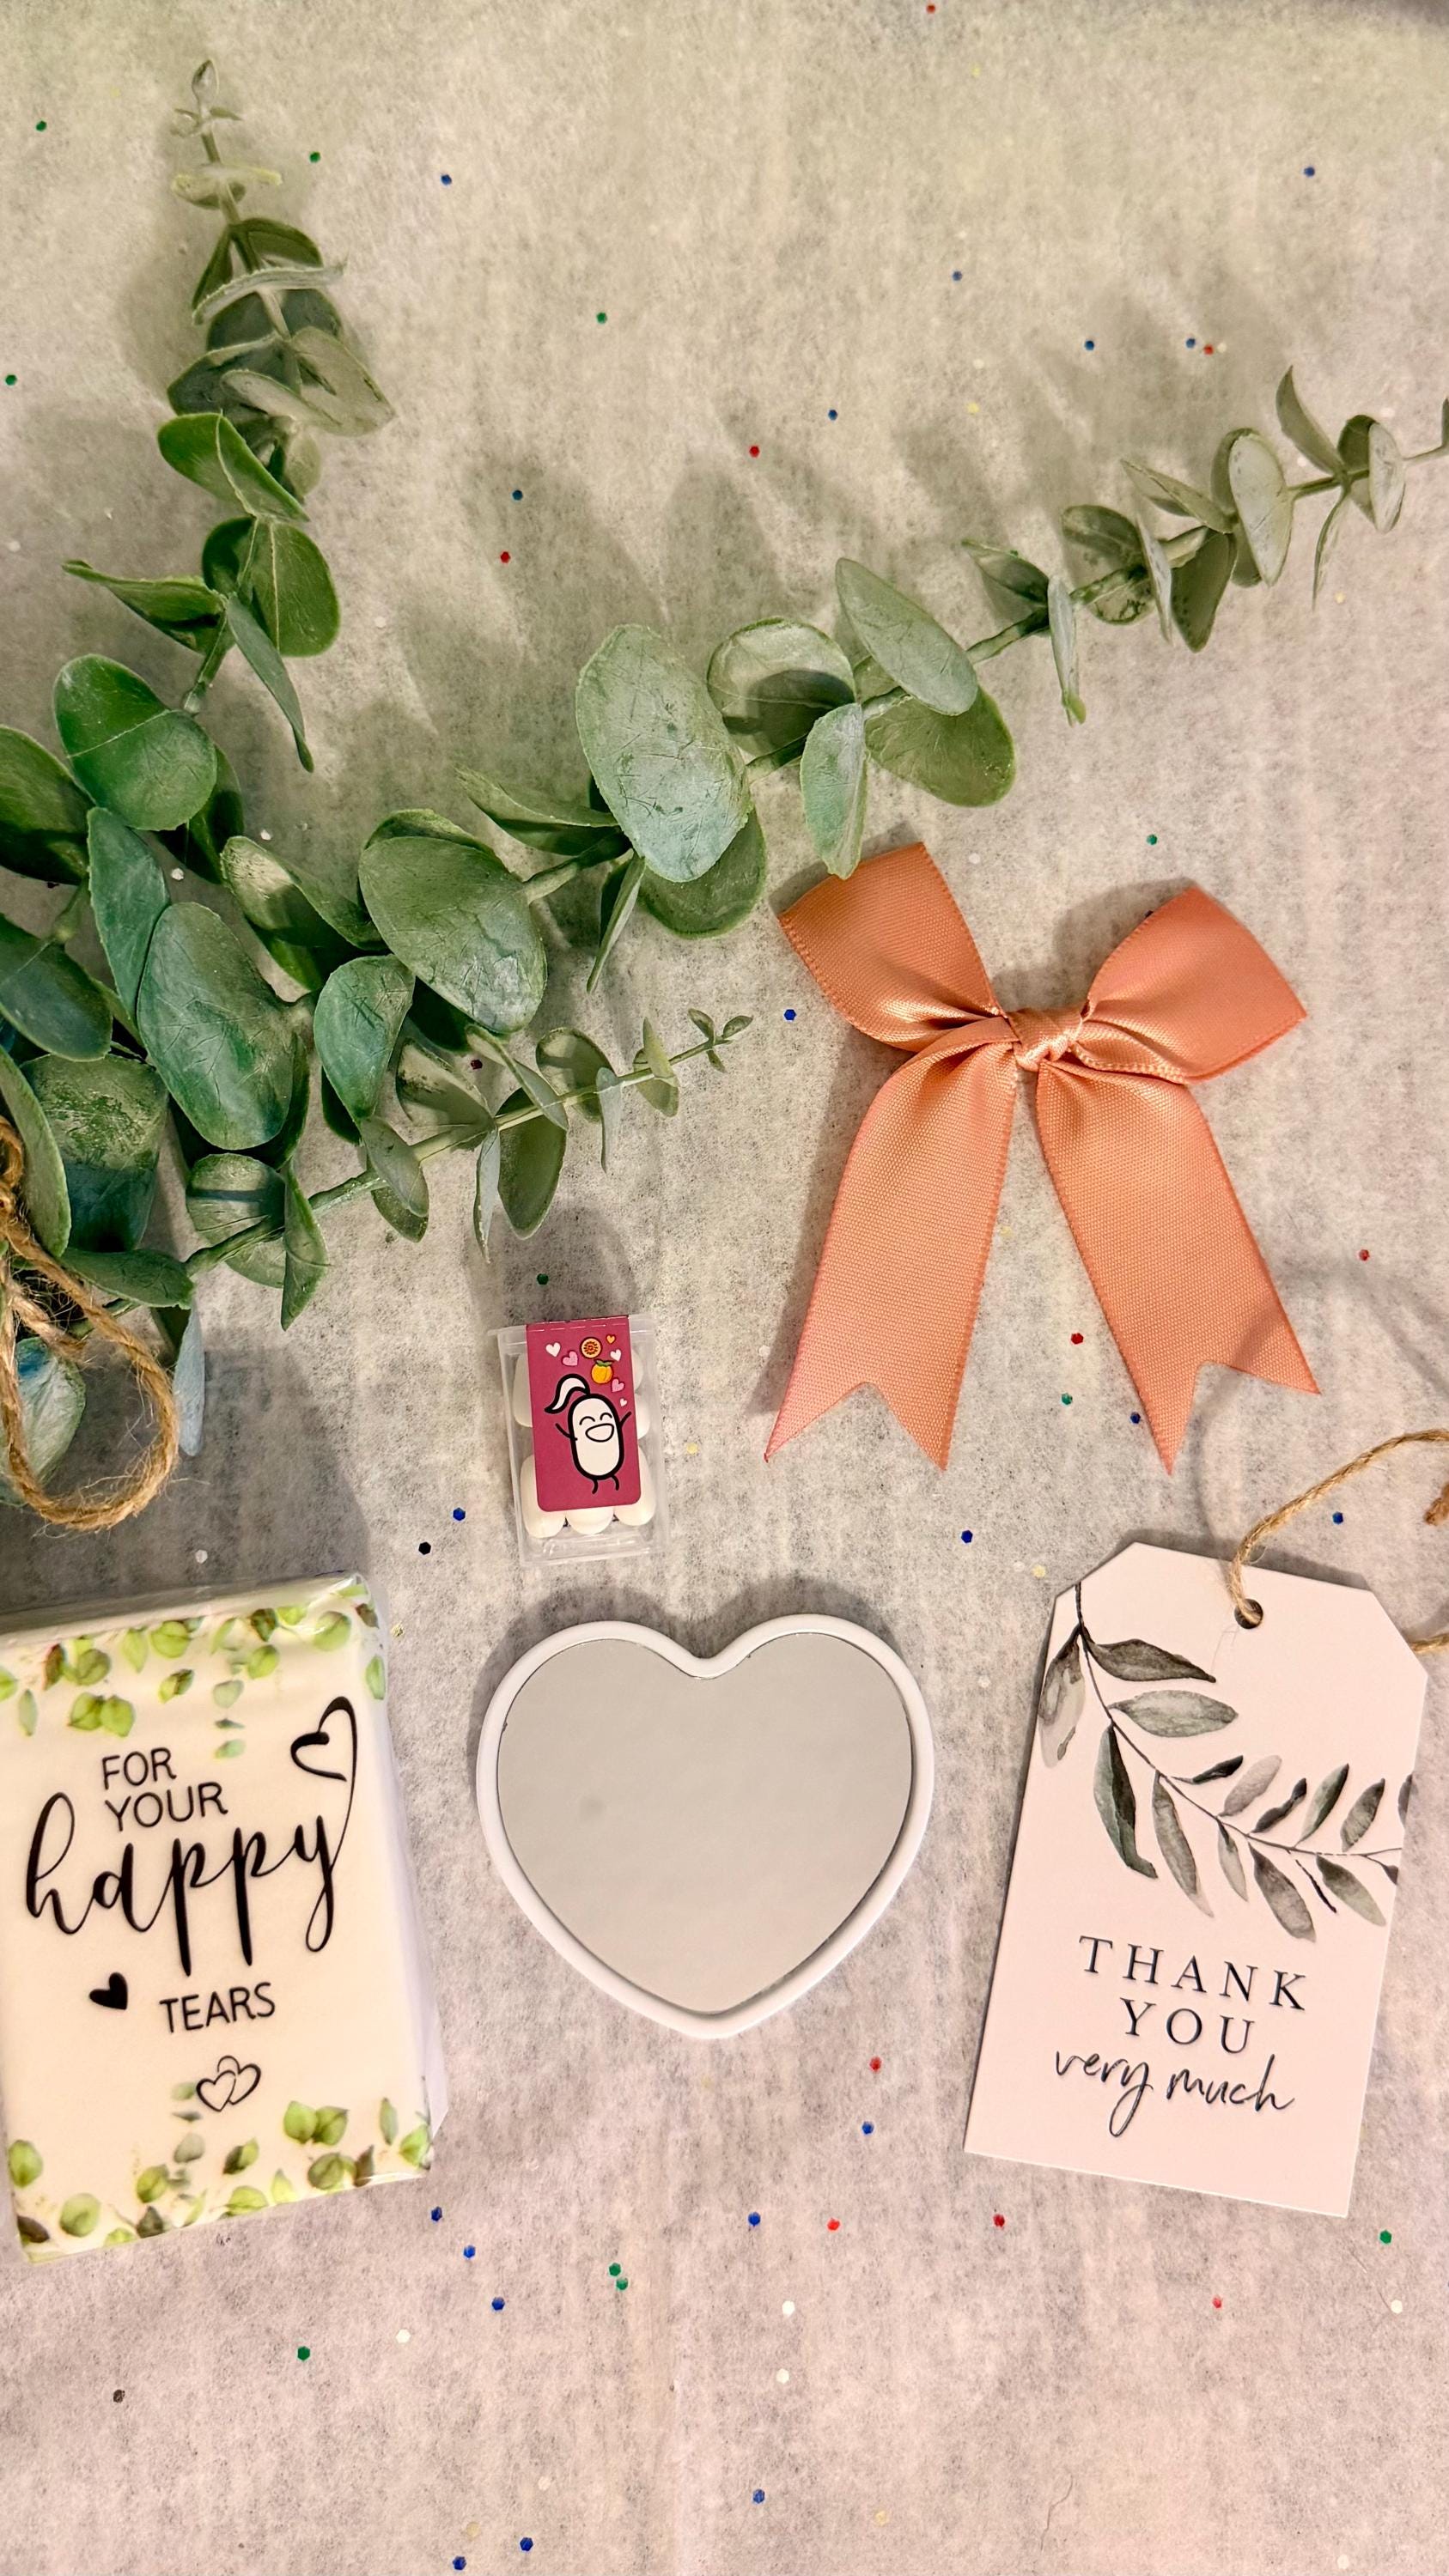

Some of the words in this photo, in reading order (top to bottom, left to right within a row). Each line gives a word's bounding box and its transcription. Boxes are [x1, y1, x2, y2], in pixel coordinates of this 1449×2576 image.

[102, 1747, 177, 1789] FOR
[105, 1781, 228, 1832] YOUR
[25, 1792, 348, 1977] happy
[1078, 1935, 1306, 2011] THANK
[159, 1982, 277, 2034] TEARS
[1119, 1996, 1255, 2055] YOU
[1055, 2049, 1154, 2138] very
[1166, 2053, 1295, 2113] much
